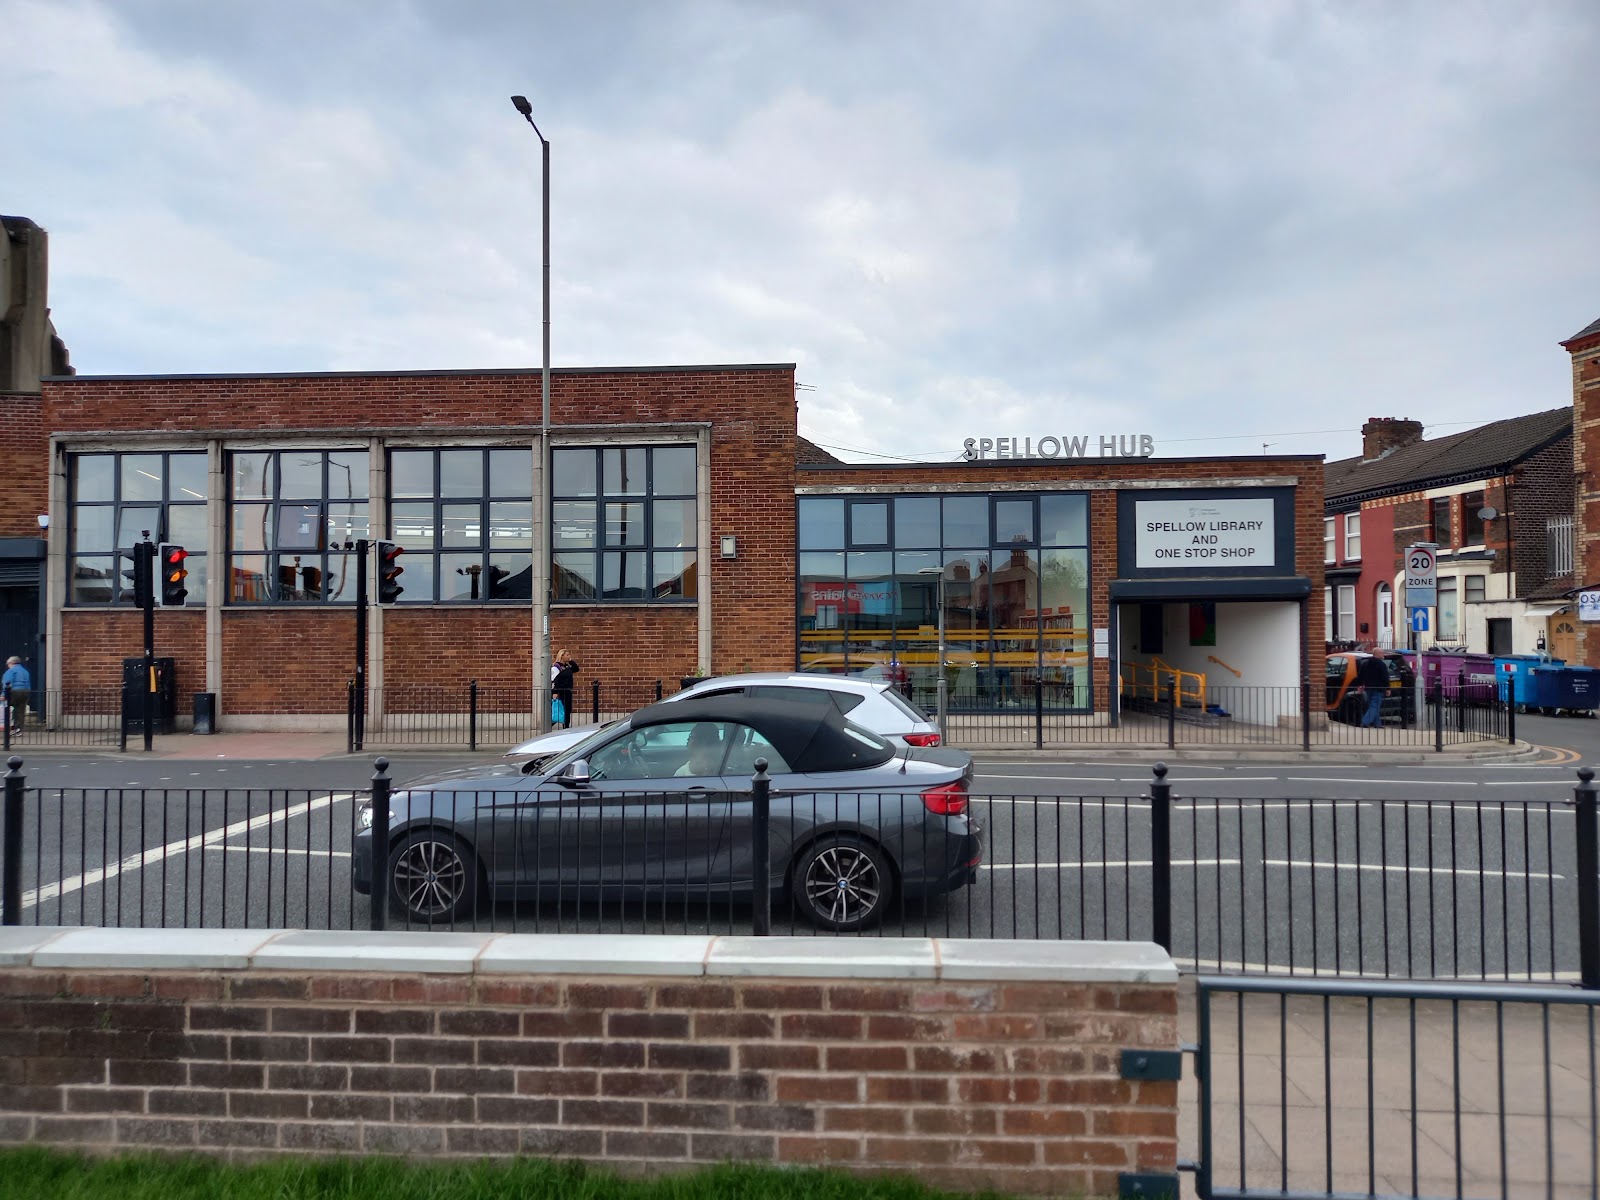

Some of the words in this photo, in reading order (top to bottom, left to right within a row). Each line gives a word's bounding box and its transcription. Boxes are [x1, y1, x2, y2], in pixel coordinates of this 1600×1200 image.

[963, 436, 1089, 460] SPELLOW
[1099, 434, 1155, 458] HUB
[1146, 521, 1206, 532] SPELLOW
[1209, 520, 1264, 532] LIBRARY
[1191, 534, 1219, 545] AND
[1154, 548, 1182, 559] ONE
[1184, 547, 1217, 558] STOP
[1220, 547, 1256, 558] SHOP
[1411, 557, 1430, 569] 20
[1408, 578, 1434, 586] ZONE
